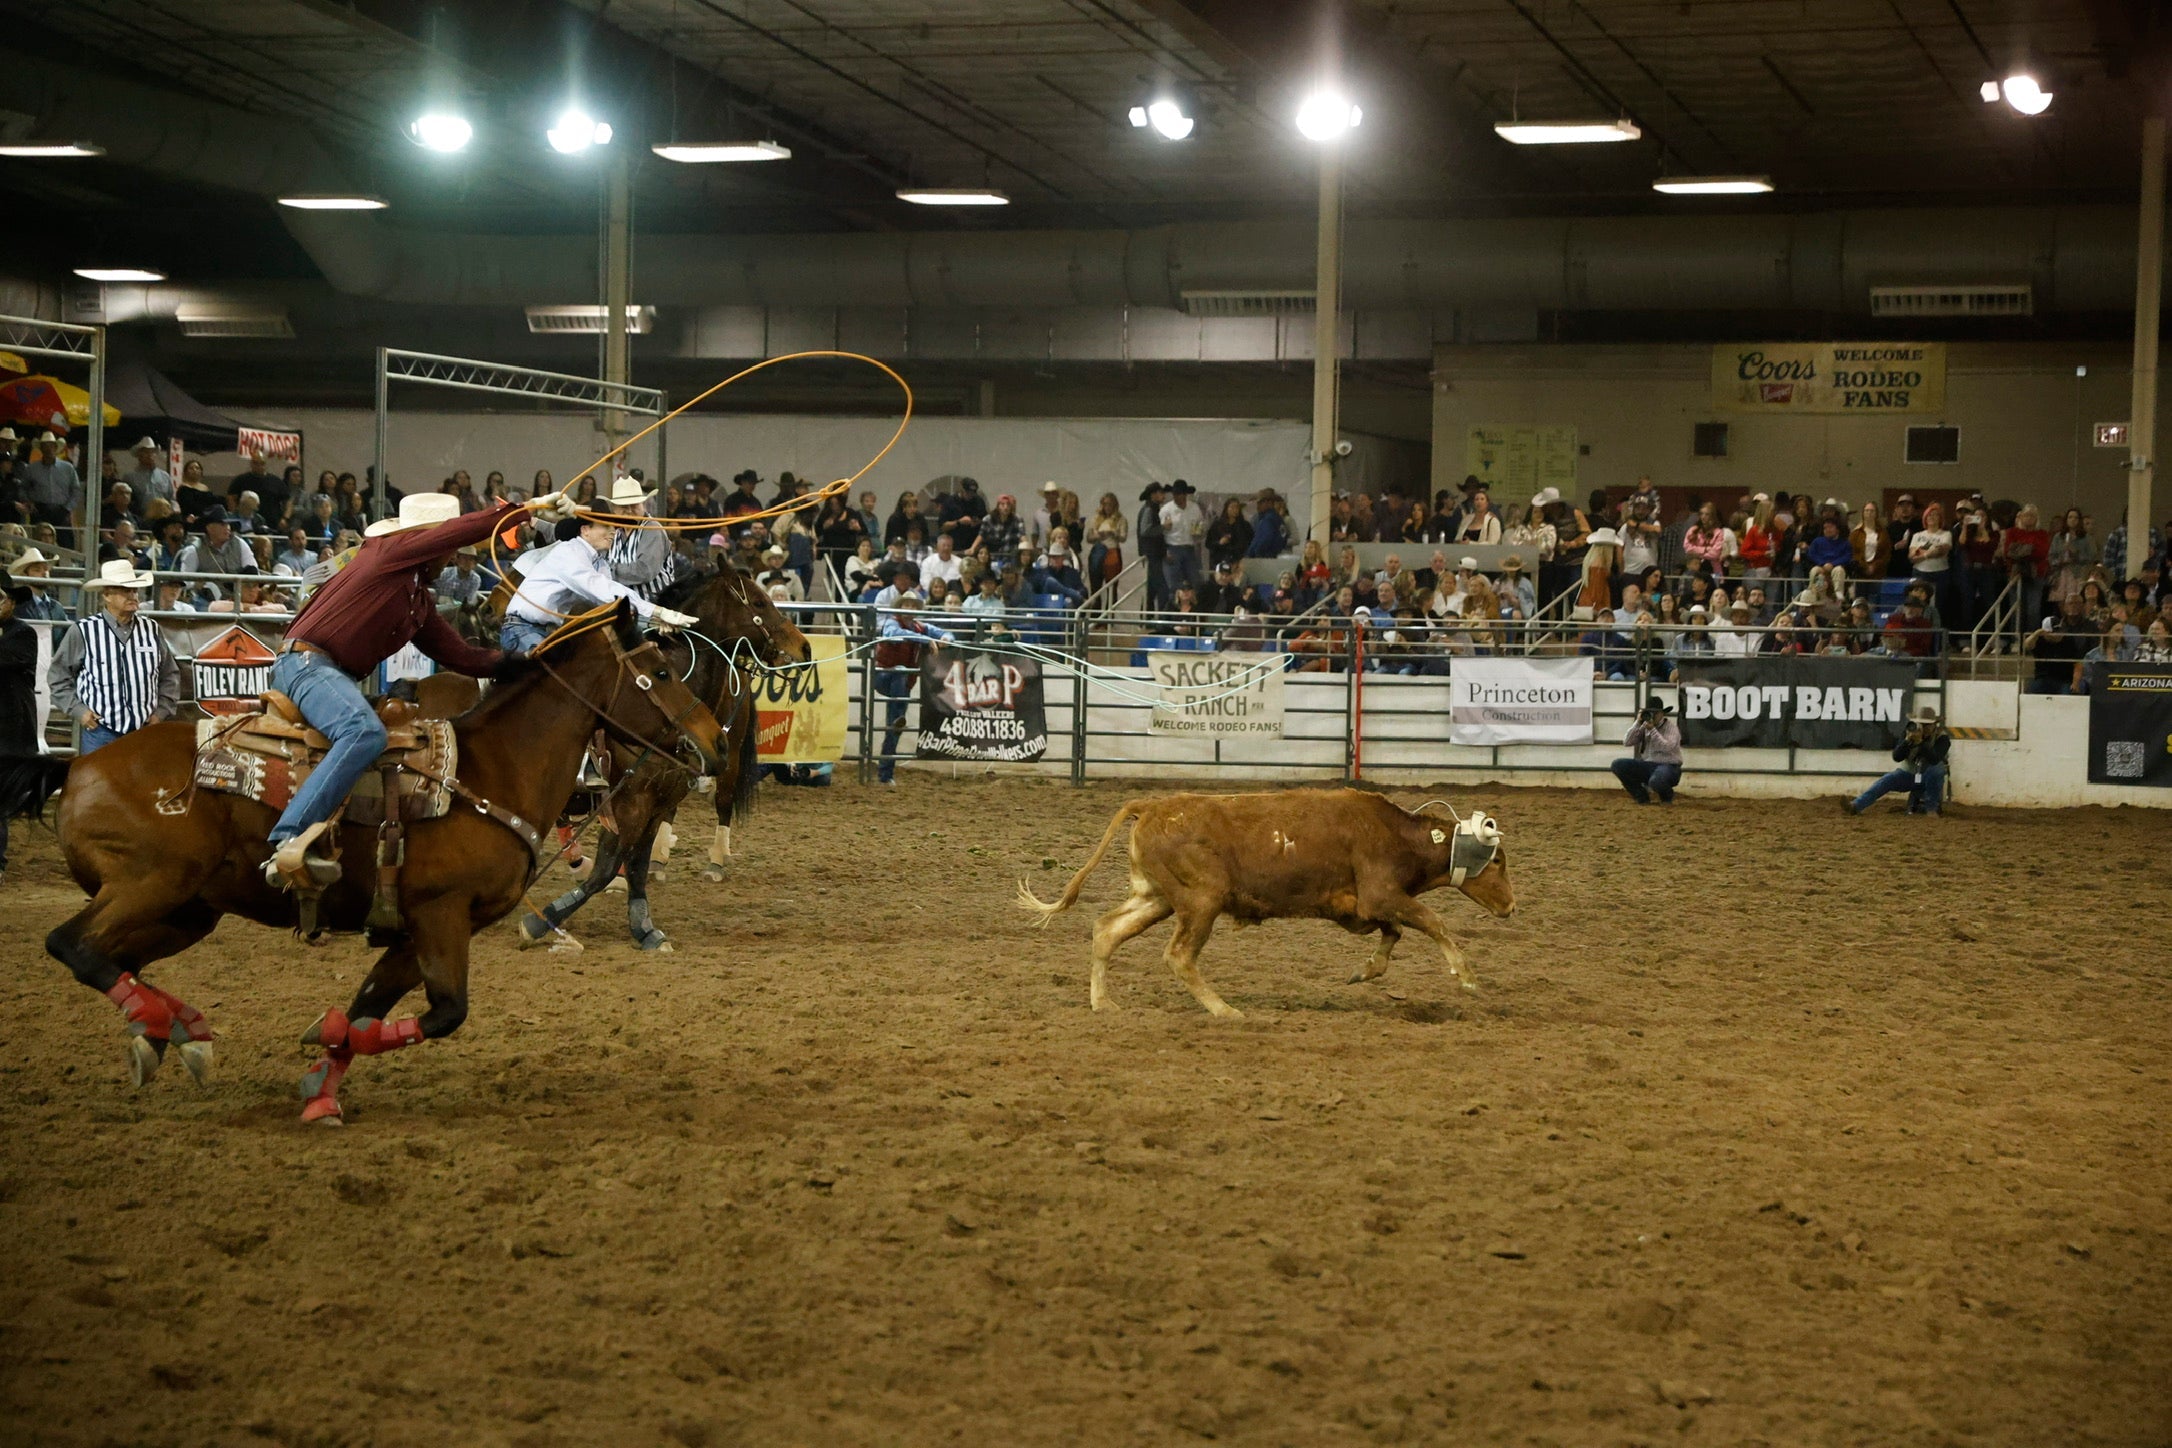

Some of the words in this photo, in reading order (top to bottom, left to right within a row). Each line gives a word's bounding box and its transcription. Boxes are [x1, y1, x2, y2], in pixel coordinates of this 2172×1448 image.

[1738, 351, 1817, 380] Coors
[1833, 349, 1923, 361] WELCOME
[1833, 371, 1922, 388] RODEO
[1842, 390, 1910, 408] FANS
[239, 430, 264, 456] HOT
[266, 434, 299, 461] DOGS
[195, 665, 236, 698] FOLEY
[238, 665, 272, 696] RANC
[750, 659, 823, 703] oors
[943, 661, 967, 707] 4
[967, 679, 999, 703] BAR
[1001, 664, 1023, 708] P
[1160, 661, 1272, 692] SACKETT
[2121, 678, 2172, 688] ARIZONA
[1468, 682, 1576, 703] Princeton
[1685, 686, 1789, 720] BOOT
[1795, 686, 1906, 722] BARN
[1185, 695, 1247, 716] RANCH
[1482, 708, 1561, 721] Construction
[755, 715, 790, 747] anquet
[1152, 719, 1206, 731] WELCOME
[1209, 722, 1246, 731] RODEO
[1249, 721, 1281, 732] FANS!
